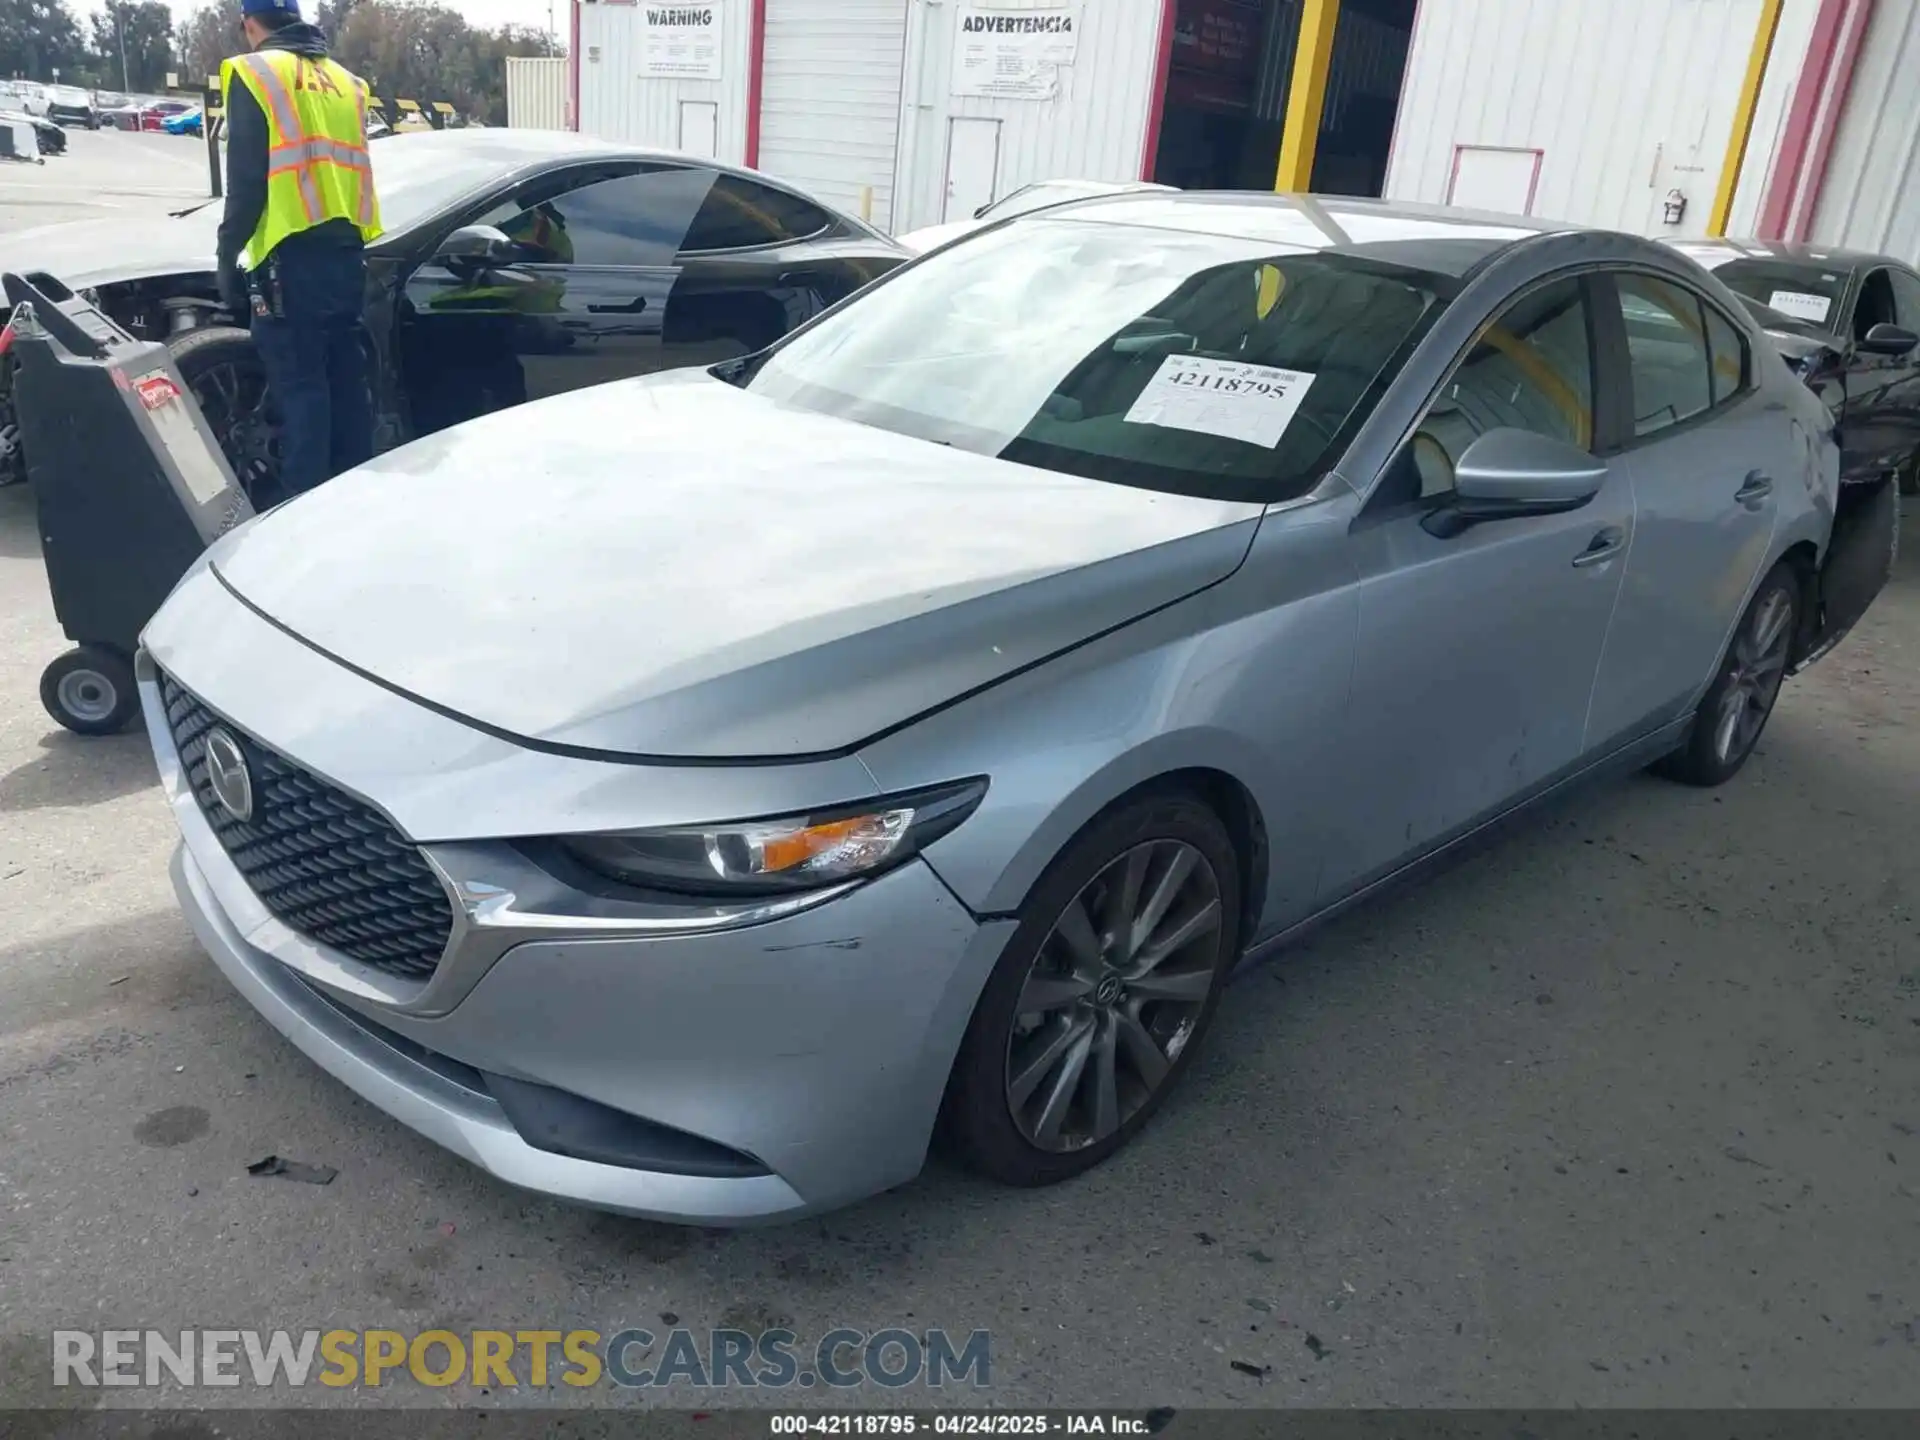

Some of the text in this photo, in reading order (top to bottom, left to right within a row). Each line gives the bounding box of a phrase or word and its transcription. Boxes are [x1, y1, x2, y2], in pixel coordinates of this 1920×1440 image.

[646, 9, 712, 26] WARNING
[962, 16, 1072, 33] ADVERTENCIA
[1168, 371, 1288, 400] 42118795
